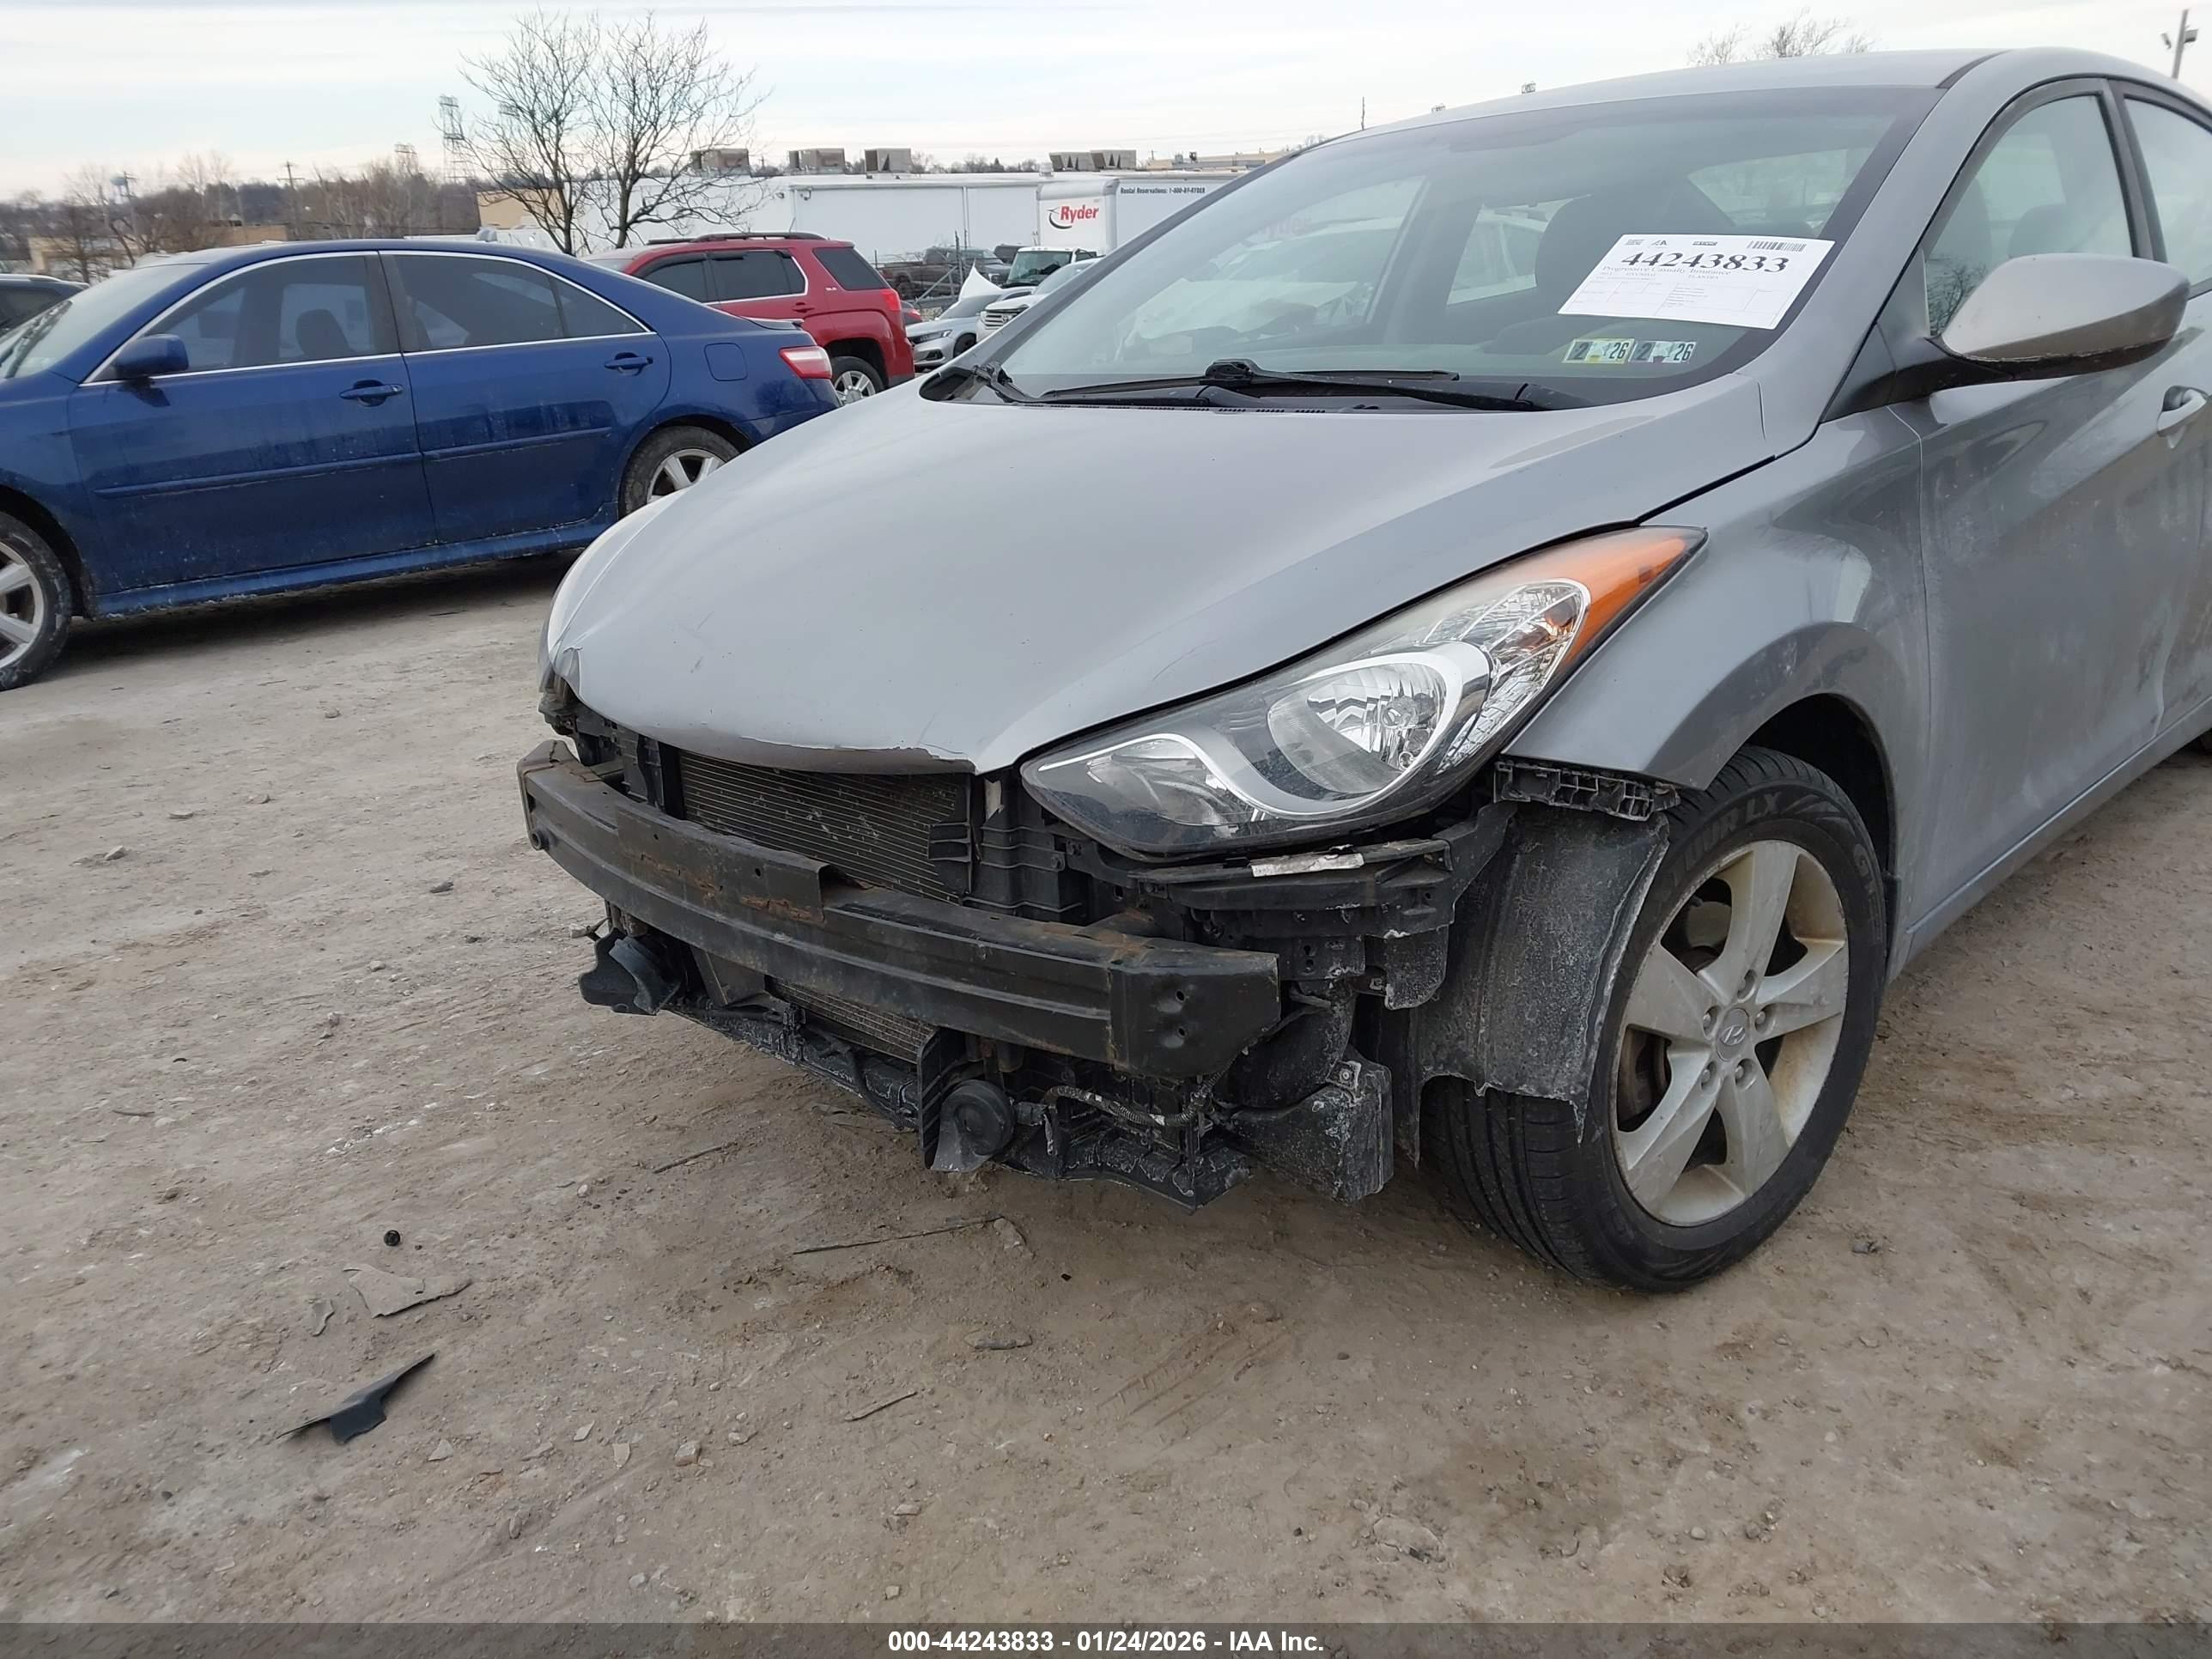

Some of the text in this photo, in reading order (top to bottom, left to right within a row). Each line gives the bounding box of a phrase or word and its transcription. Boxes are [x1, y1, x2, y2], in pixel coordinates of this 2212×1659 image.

[1060, 204, 1099, 223] Ryder
[1621, 252, 1790, 273] 44243833
[1608, 343, 1630, 360] 26
[1674, 343, 1694, 362] 26
